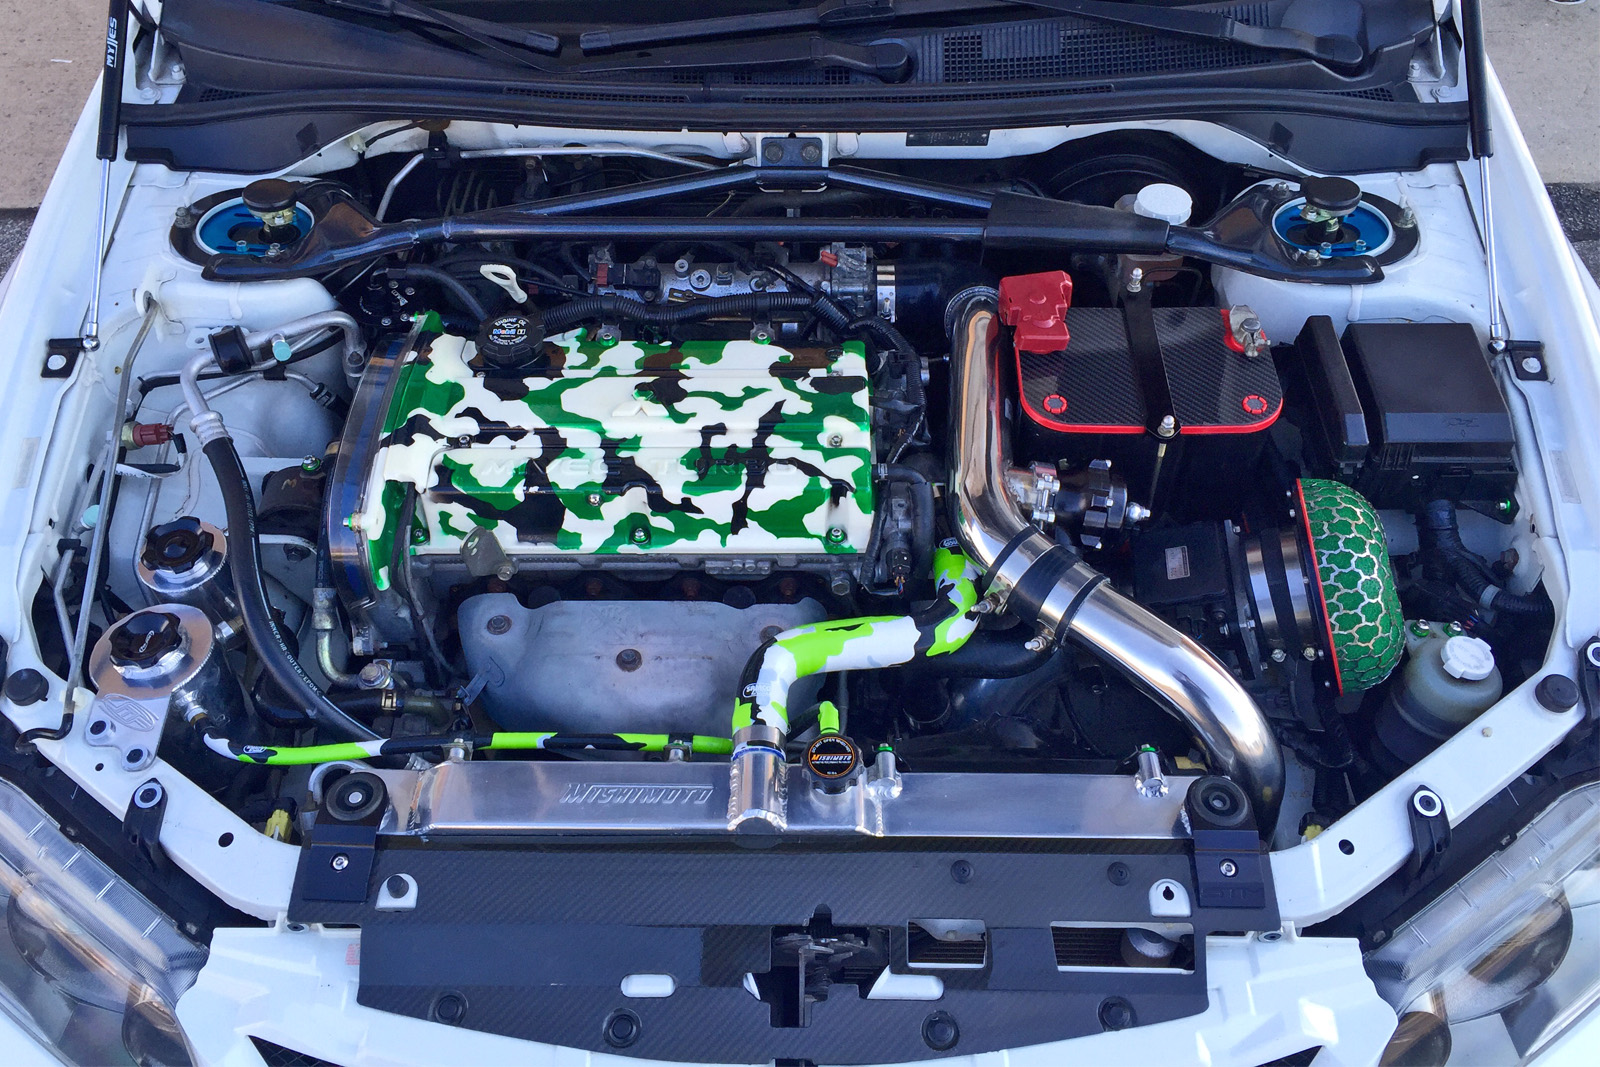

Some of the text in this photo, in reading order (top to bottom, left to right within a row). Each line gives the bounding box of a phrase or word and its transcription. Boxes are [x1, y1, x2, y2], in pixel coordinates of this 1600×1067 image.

[495, 318, 517, 327] ENGINE
[648, 457, 799, 476] TURBO
[559, 783, 714, 804] MISHIMOTO
